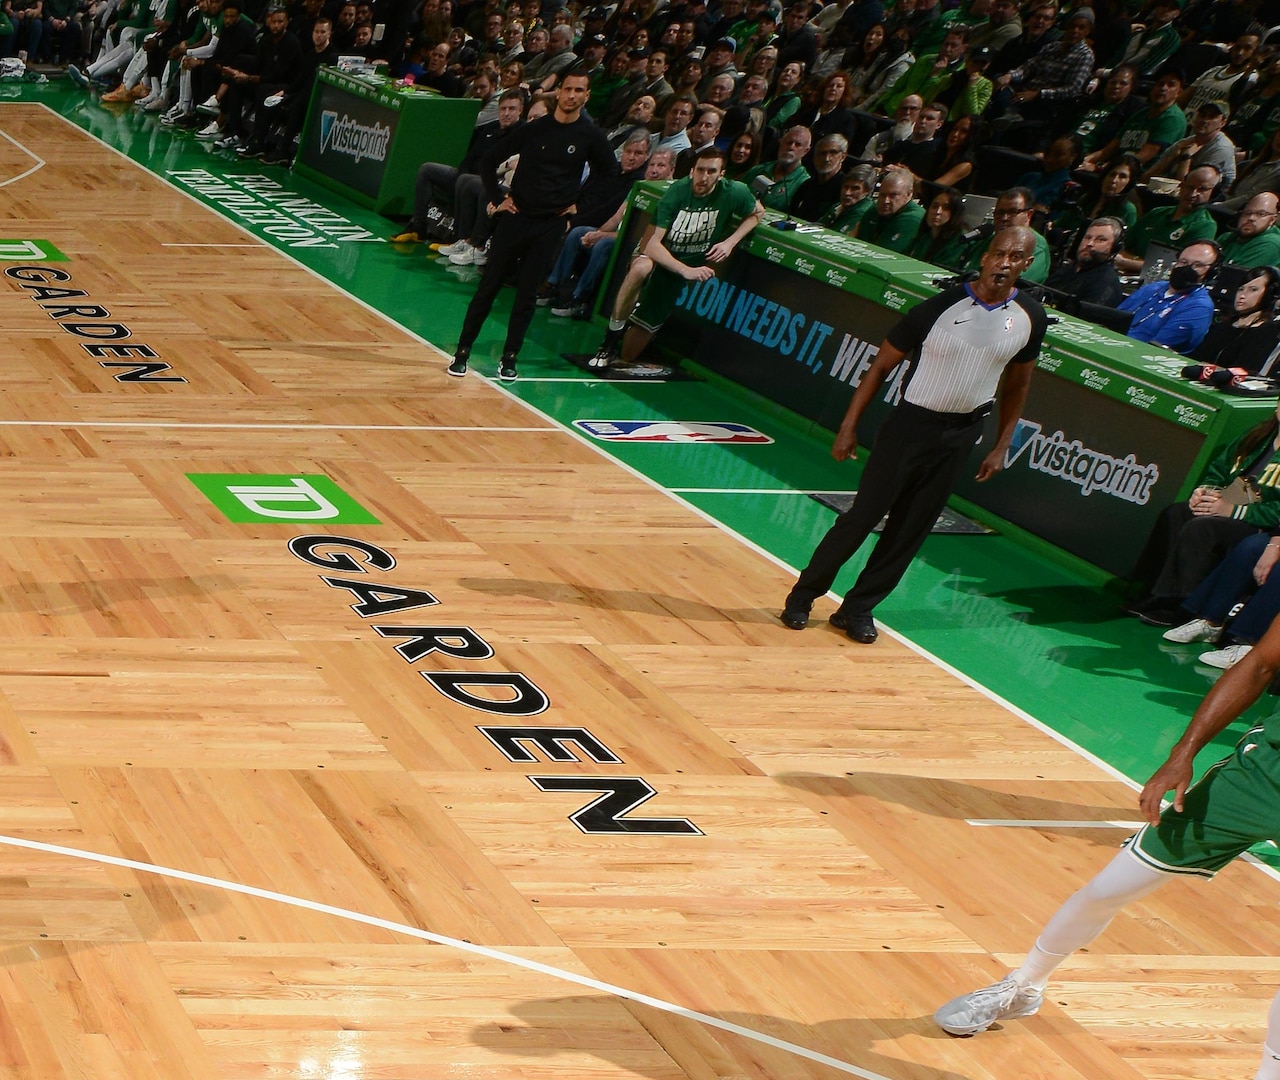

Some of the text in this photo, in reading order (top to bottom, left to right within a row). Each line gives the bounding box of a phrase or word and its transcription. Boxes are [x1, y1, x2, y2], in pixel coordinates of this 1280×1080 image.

[333, 115, 390, 162] vistaprint
[165, 168, 339, 249] TEMPLETON
[222, 173, 387, 243] FRANKLIN
[672, 209, 719, 235] BLACK
[3, 265, 190, 384] GARDEN
[726, 288, 804, 356] NEEDS
[796, 320, 834, 375] IT,
[829, 332, 880, 389] WE
[1030, 431, 1159, 504] vistaprint
[226, 478, 707, 837] TD GARDEN
